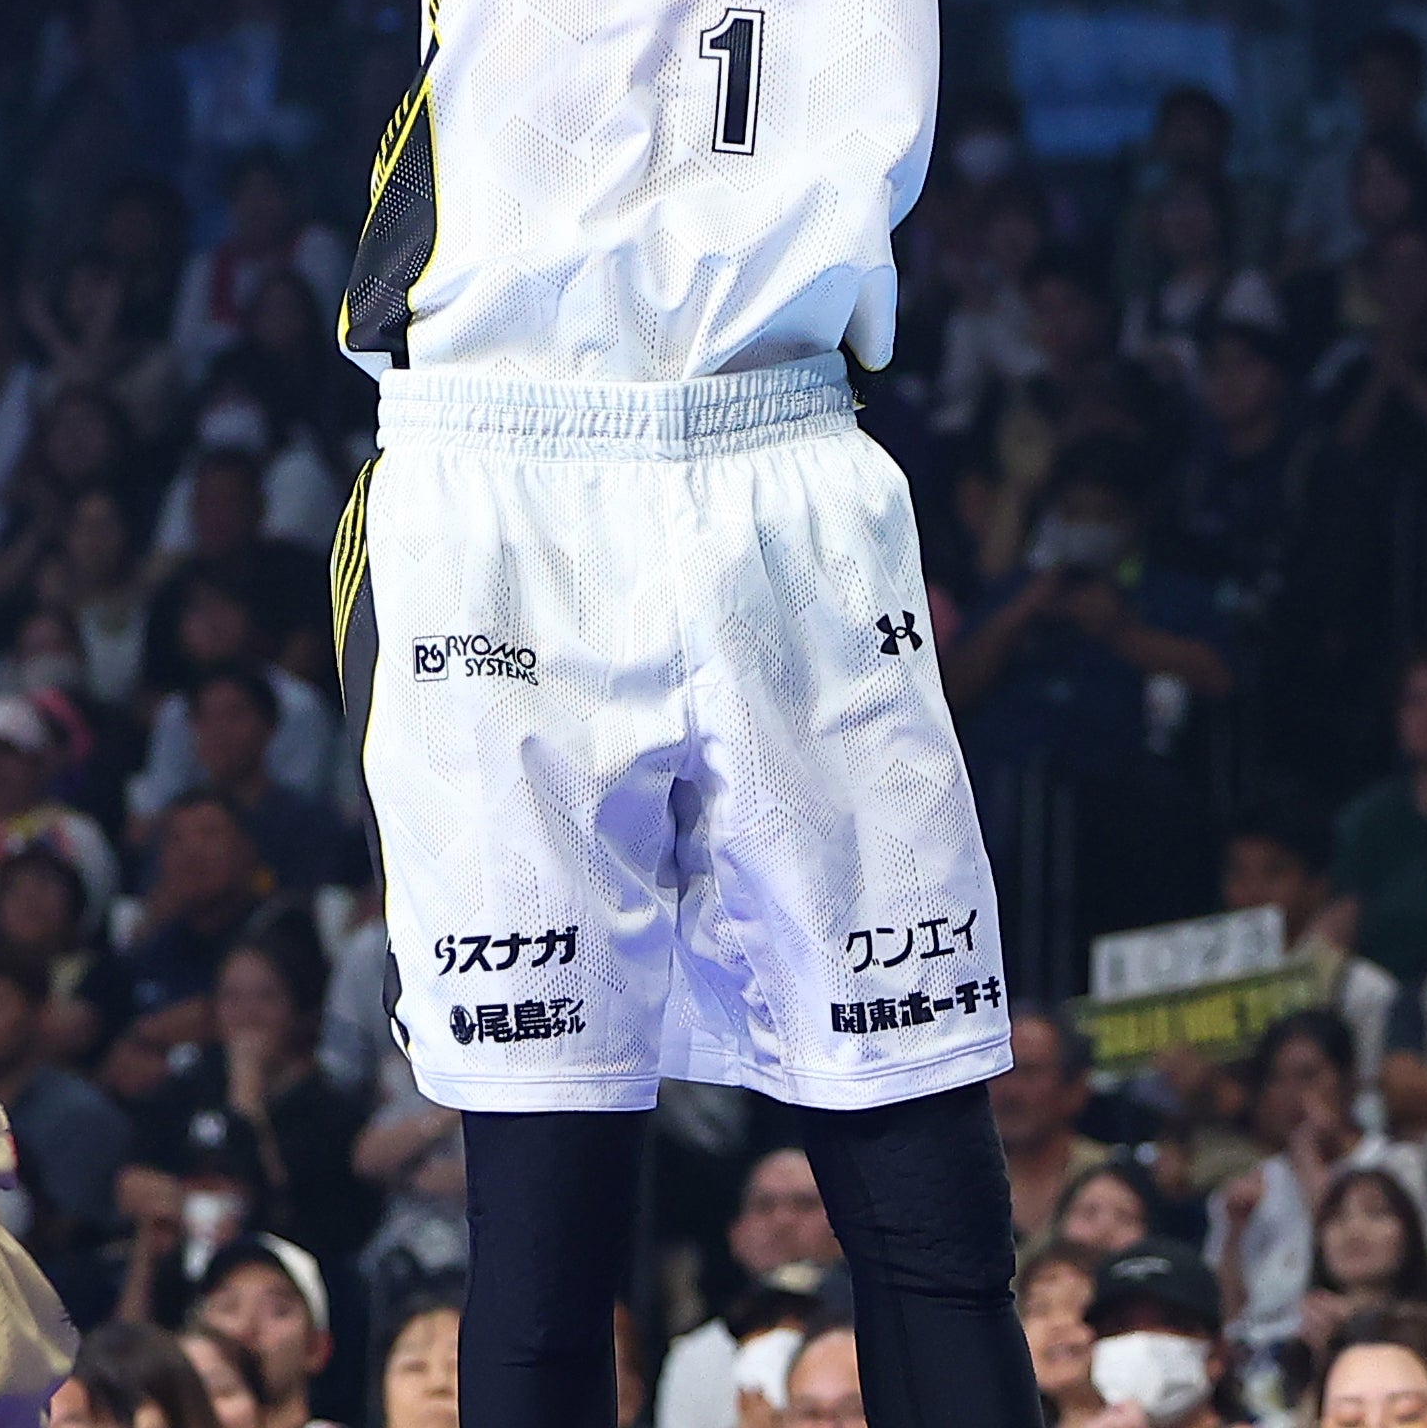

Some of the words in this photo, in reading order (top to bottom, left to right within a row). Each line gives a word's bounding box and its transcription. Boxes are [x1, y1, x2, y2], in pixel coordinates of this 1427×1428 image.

[700, 8, 764, 156] 1
[447, 634, 537, 670] RYOMO
[465, 657, 539, 686] SYSTEMS
[831, 976, 1001, 1034] 関東ホーチキ
